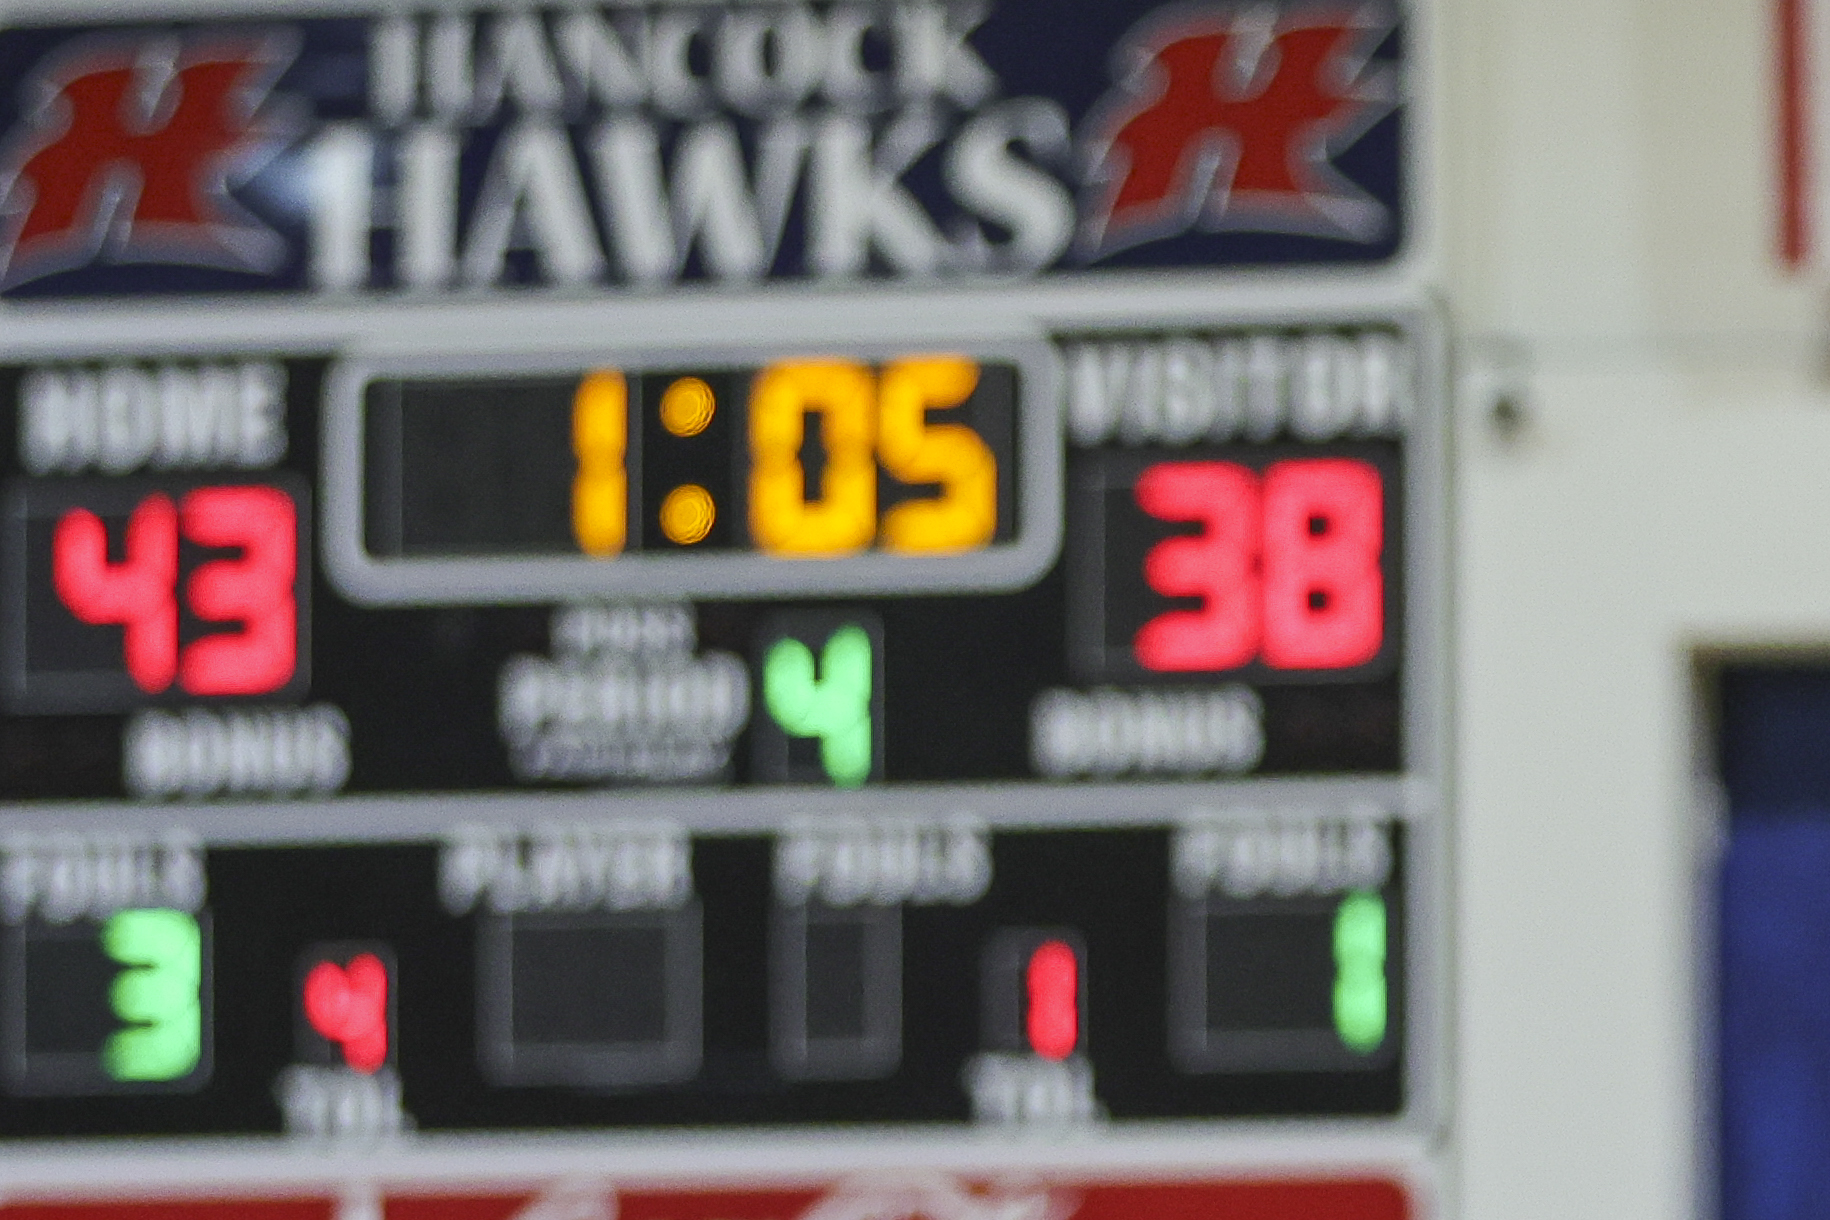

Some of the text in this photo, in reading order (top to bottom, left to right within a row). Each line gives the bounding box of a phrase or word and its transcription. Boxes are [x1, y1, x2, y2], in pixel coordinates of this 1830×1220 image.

[366, 0, 1000, 124] HANCOCK
[306, 97, 1078, 288] HAWKS
[18, 362, 290, 475] HOME
[1064, 332, 1402, 448] VISITOR
[570, 356, 998, 560] 1:05
[52, 484, 297, 696] 43
[1133, 457, 1386, 673] 38
[123, 703, 352, 800] BONUS
[762, 624, 872, 790] 4
[1028, 683, 1266, 780] BONUS
[438, 822, 696, 916] PLAYER
[773, 814, 993, 907] FOULS
[100, 906, 202, 1083] 3
[303, 952, 389, 1074] 4
[1025, 938, 1079, 1062] 1
[1332, 888, 1388, 1054] 1
